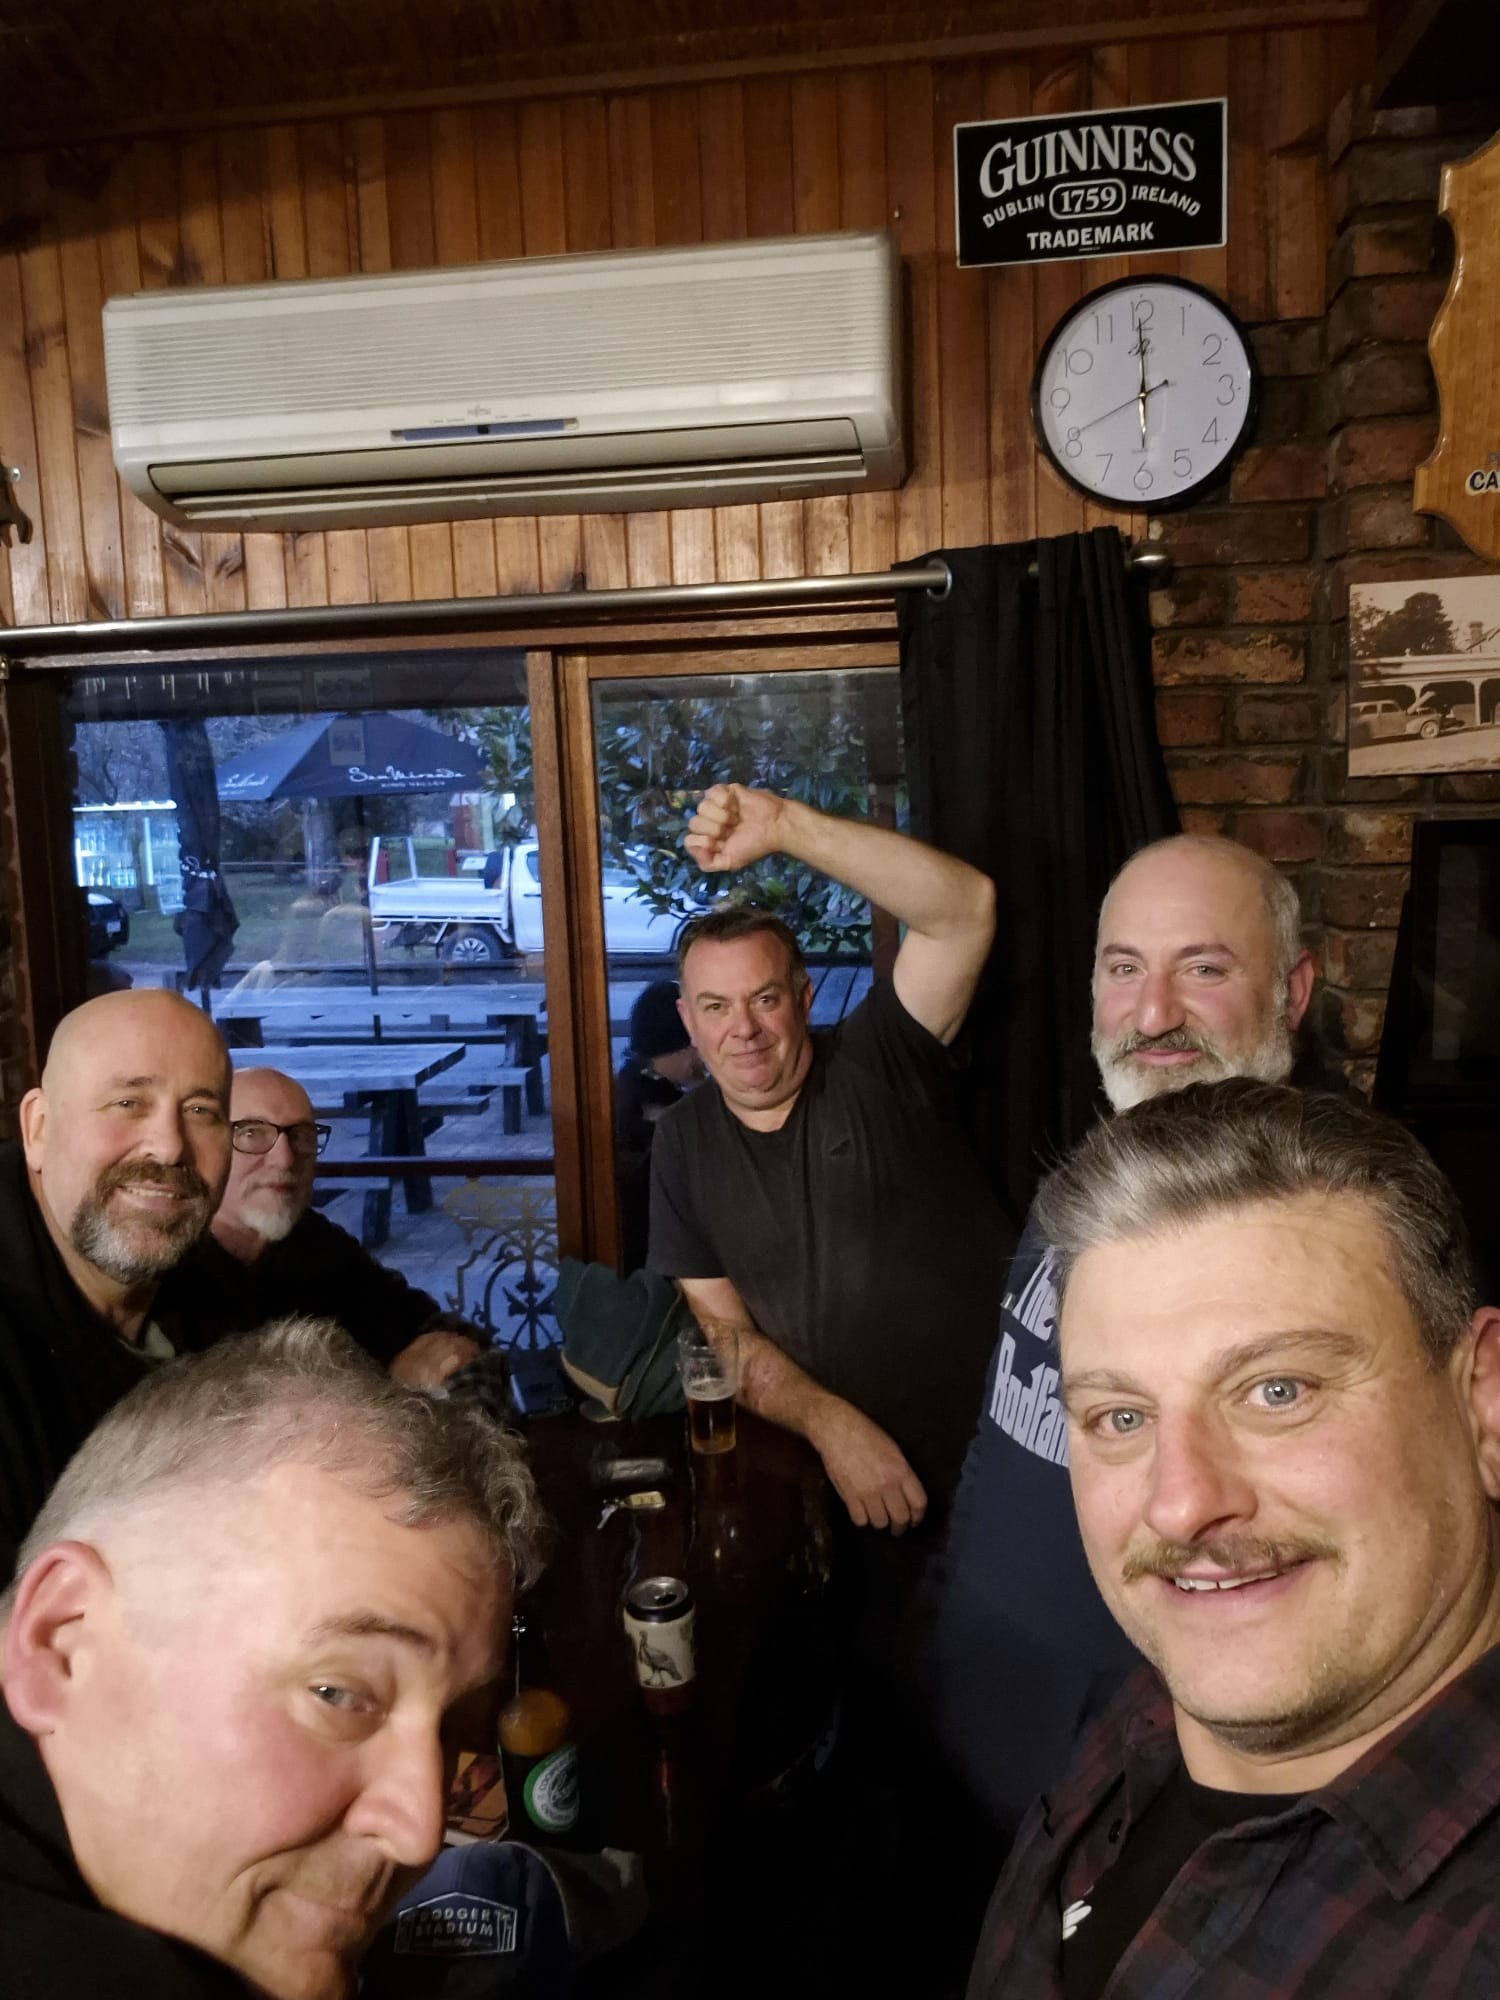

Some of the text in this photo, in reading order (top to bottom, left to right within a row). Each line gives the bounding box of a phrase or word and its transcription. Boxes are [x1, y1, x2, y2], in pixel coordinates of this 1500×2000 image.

[979, 125, 1197, 199] GUINNESS
[982, 185, 1200, 229] DUBLIN 1759 IRELAND
[1027, 221, 1154, 250] TRADEMARK
[1095, 314, 1113, 344] 11
[1130, 300, 1154, 331] 12
[1062, 348, 1093, 377] 10
[1202, 333, 1222, 365] 2
[1051, 387, 1070, 417] 9
[1217, 374, 1235, 406] 3
[1065, 427, 1082, 458] 8
[1201, 417, 1220, 445] 4
[1096, 453, 1113, 481] 7
[1133, 460, 1153, 490] 6
[1173, 449, 1192, 478] 5
[1469, 470, 1500, 491] CA
